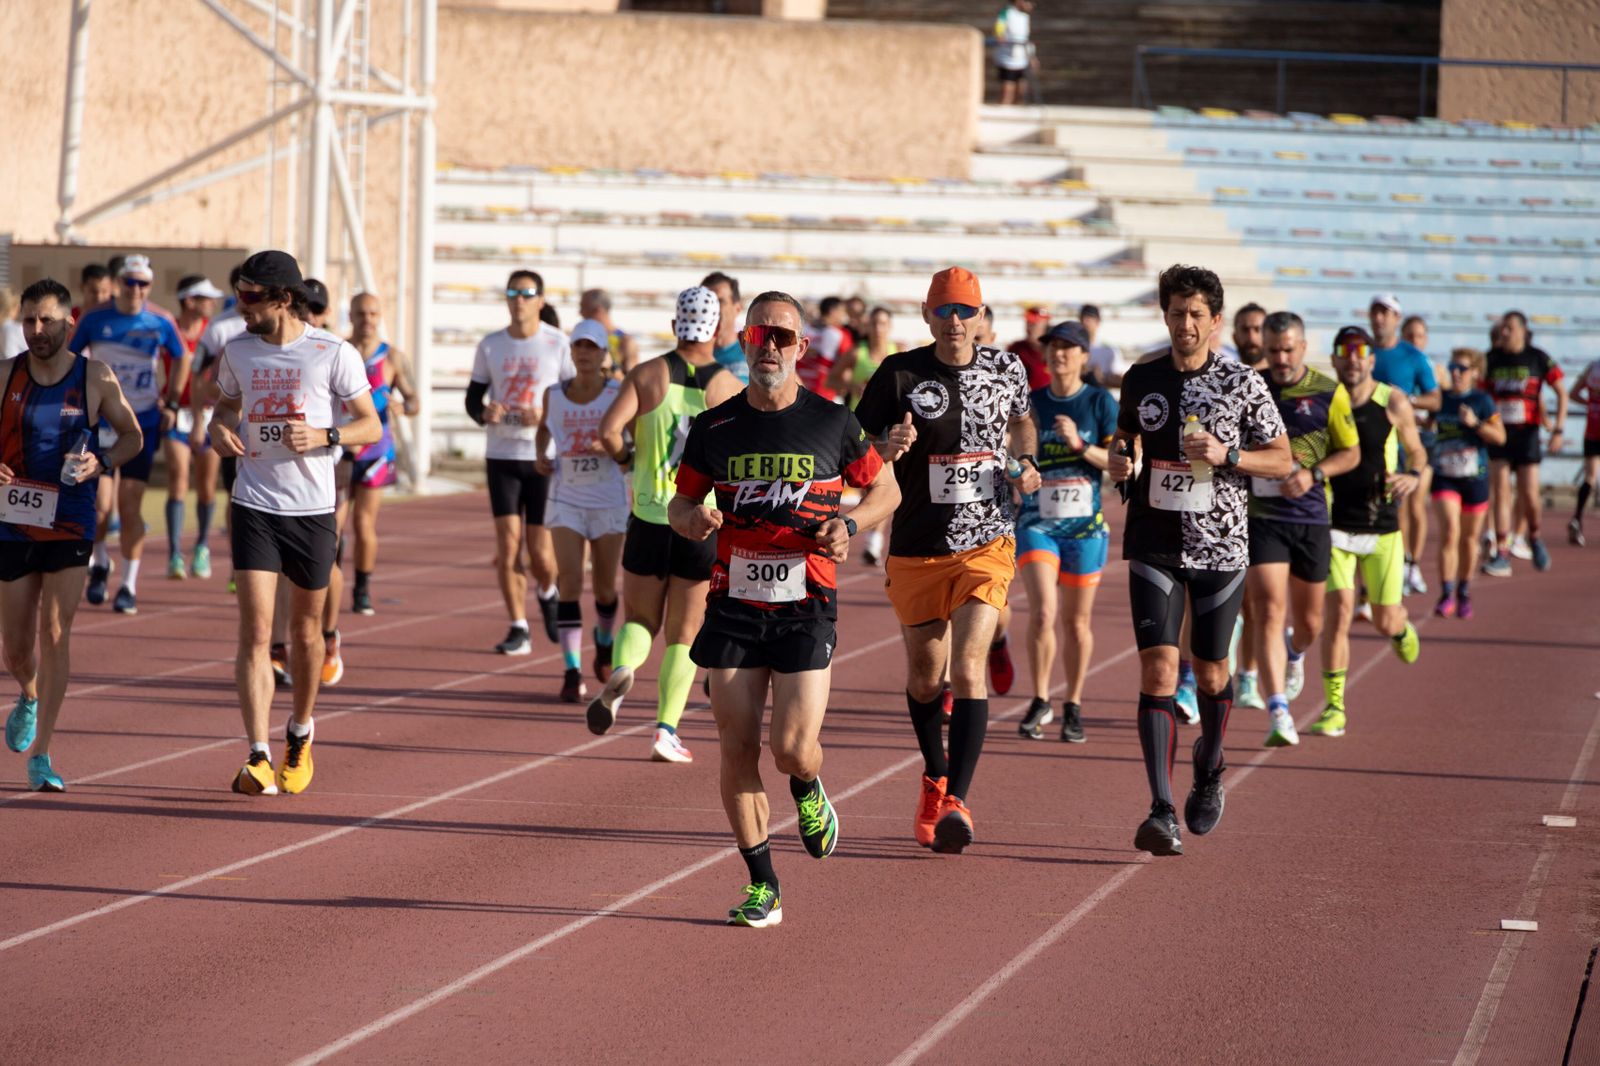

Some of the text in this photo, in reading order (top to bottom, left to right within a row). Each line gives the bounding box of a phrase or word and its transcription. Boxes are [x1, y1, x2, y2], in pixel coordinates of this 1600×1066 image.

[572, 458, 600, 473] 723
[730, 457, 811, 480] LERUS
[945, 466, 980, 485] 295
[1161, 474, 1195, 492] 427
[8, 489, 43, 508] 645
[729, 478, 814, 512] TEAM
[1051, 488, 1080, 503] 472
[746, 563, 789, 582] 300
